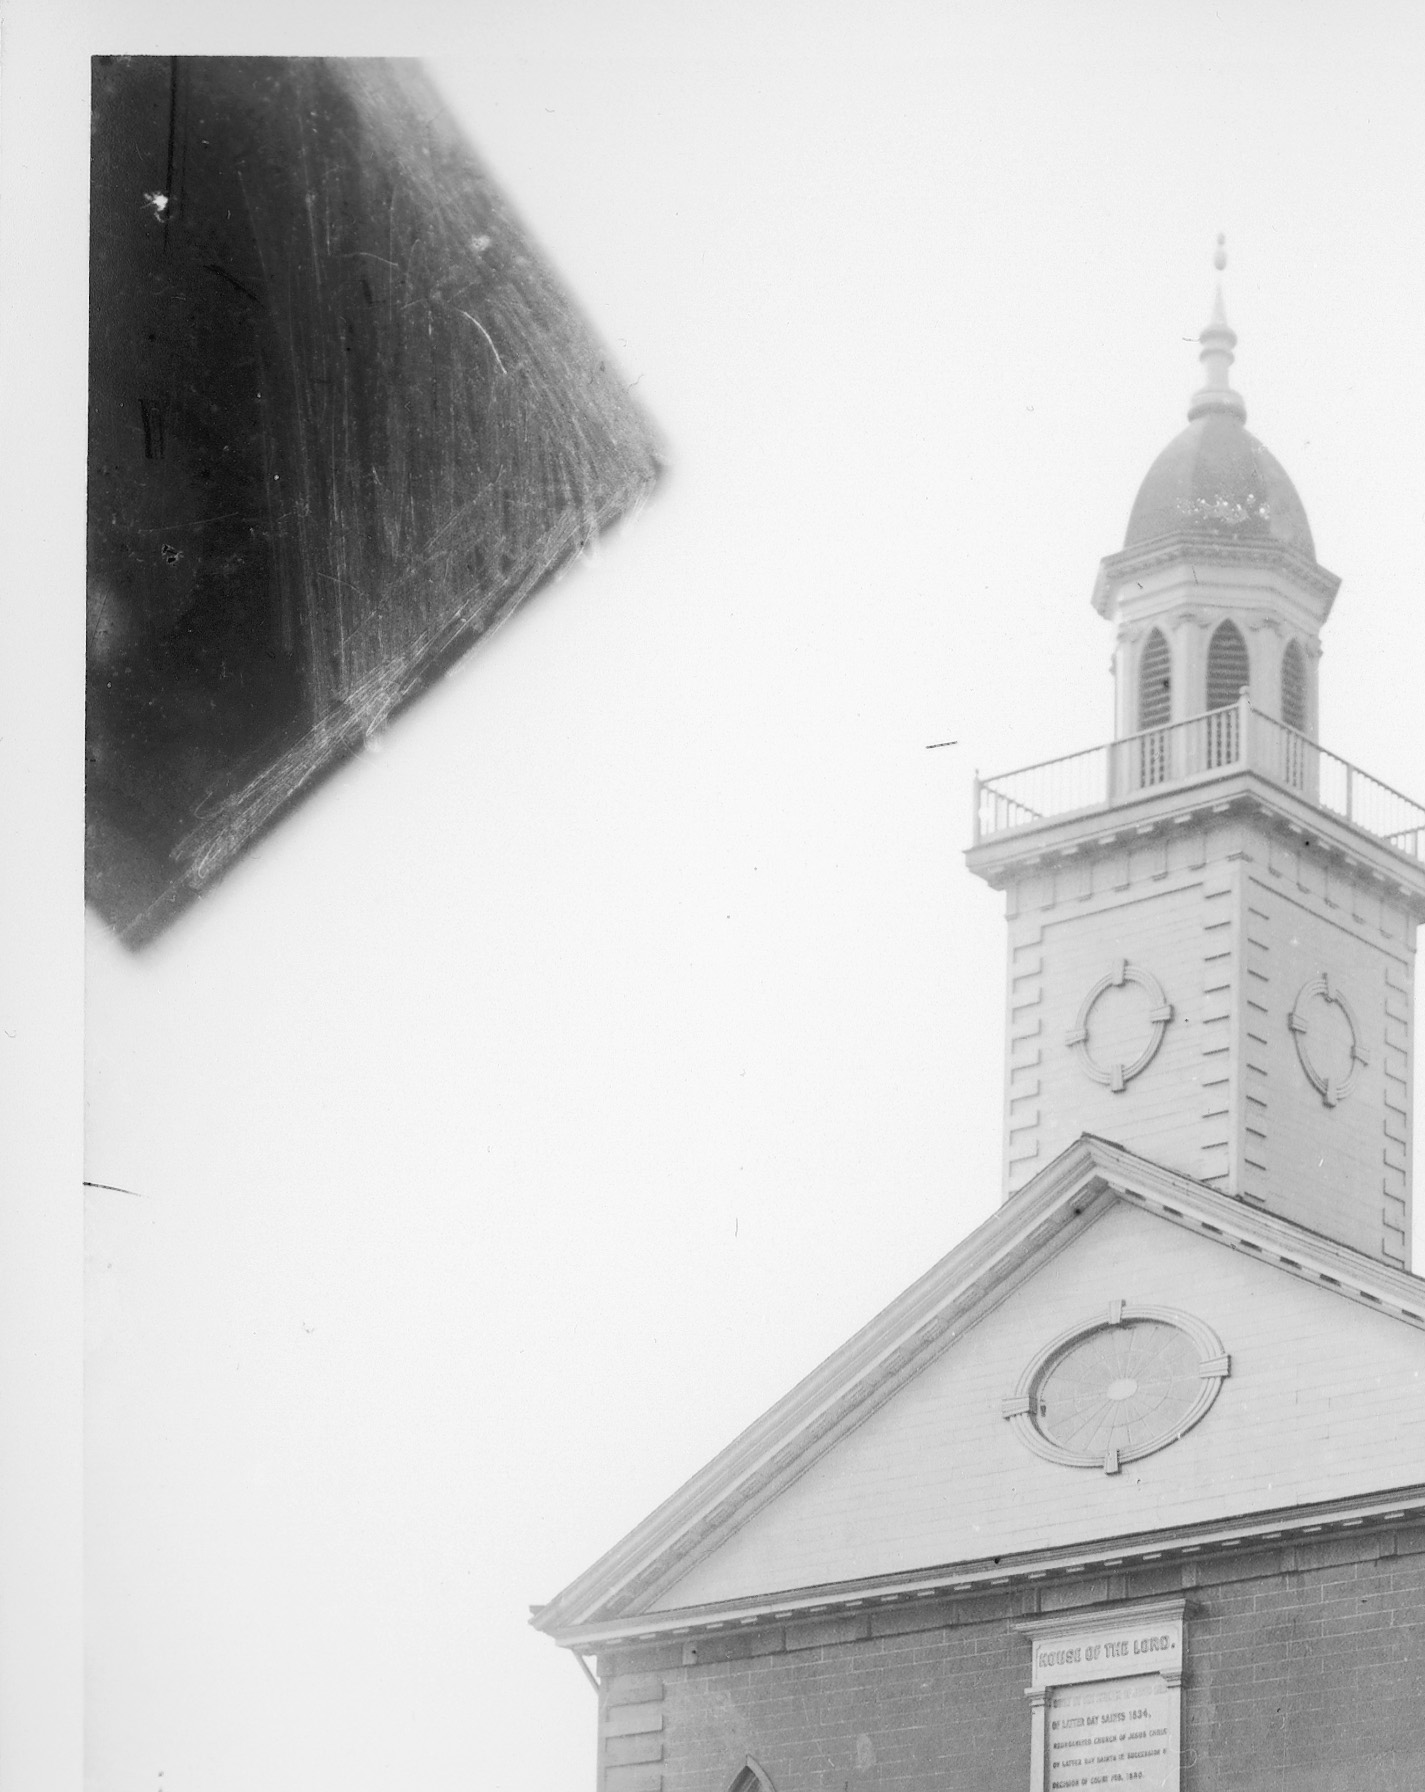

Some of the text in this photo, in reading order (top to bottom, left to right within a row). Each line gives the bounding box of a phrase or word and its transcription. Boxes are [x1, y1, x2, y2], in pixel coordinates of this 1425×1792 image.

[1039, 1635, 1176, 1667] HOUSE OF THE LORD.
